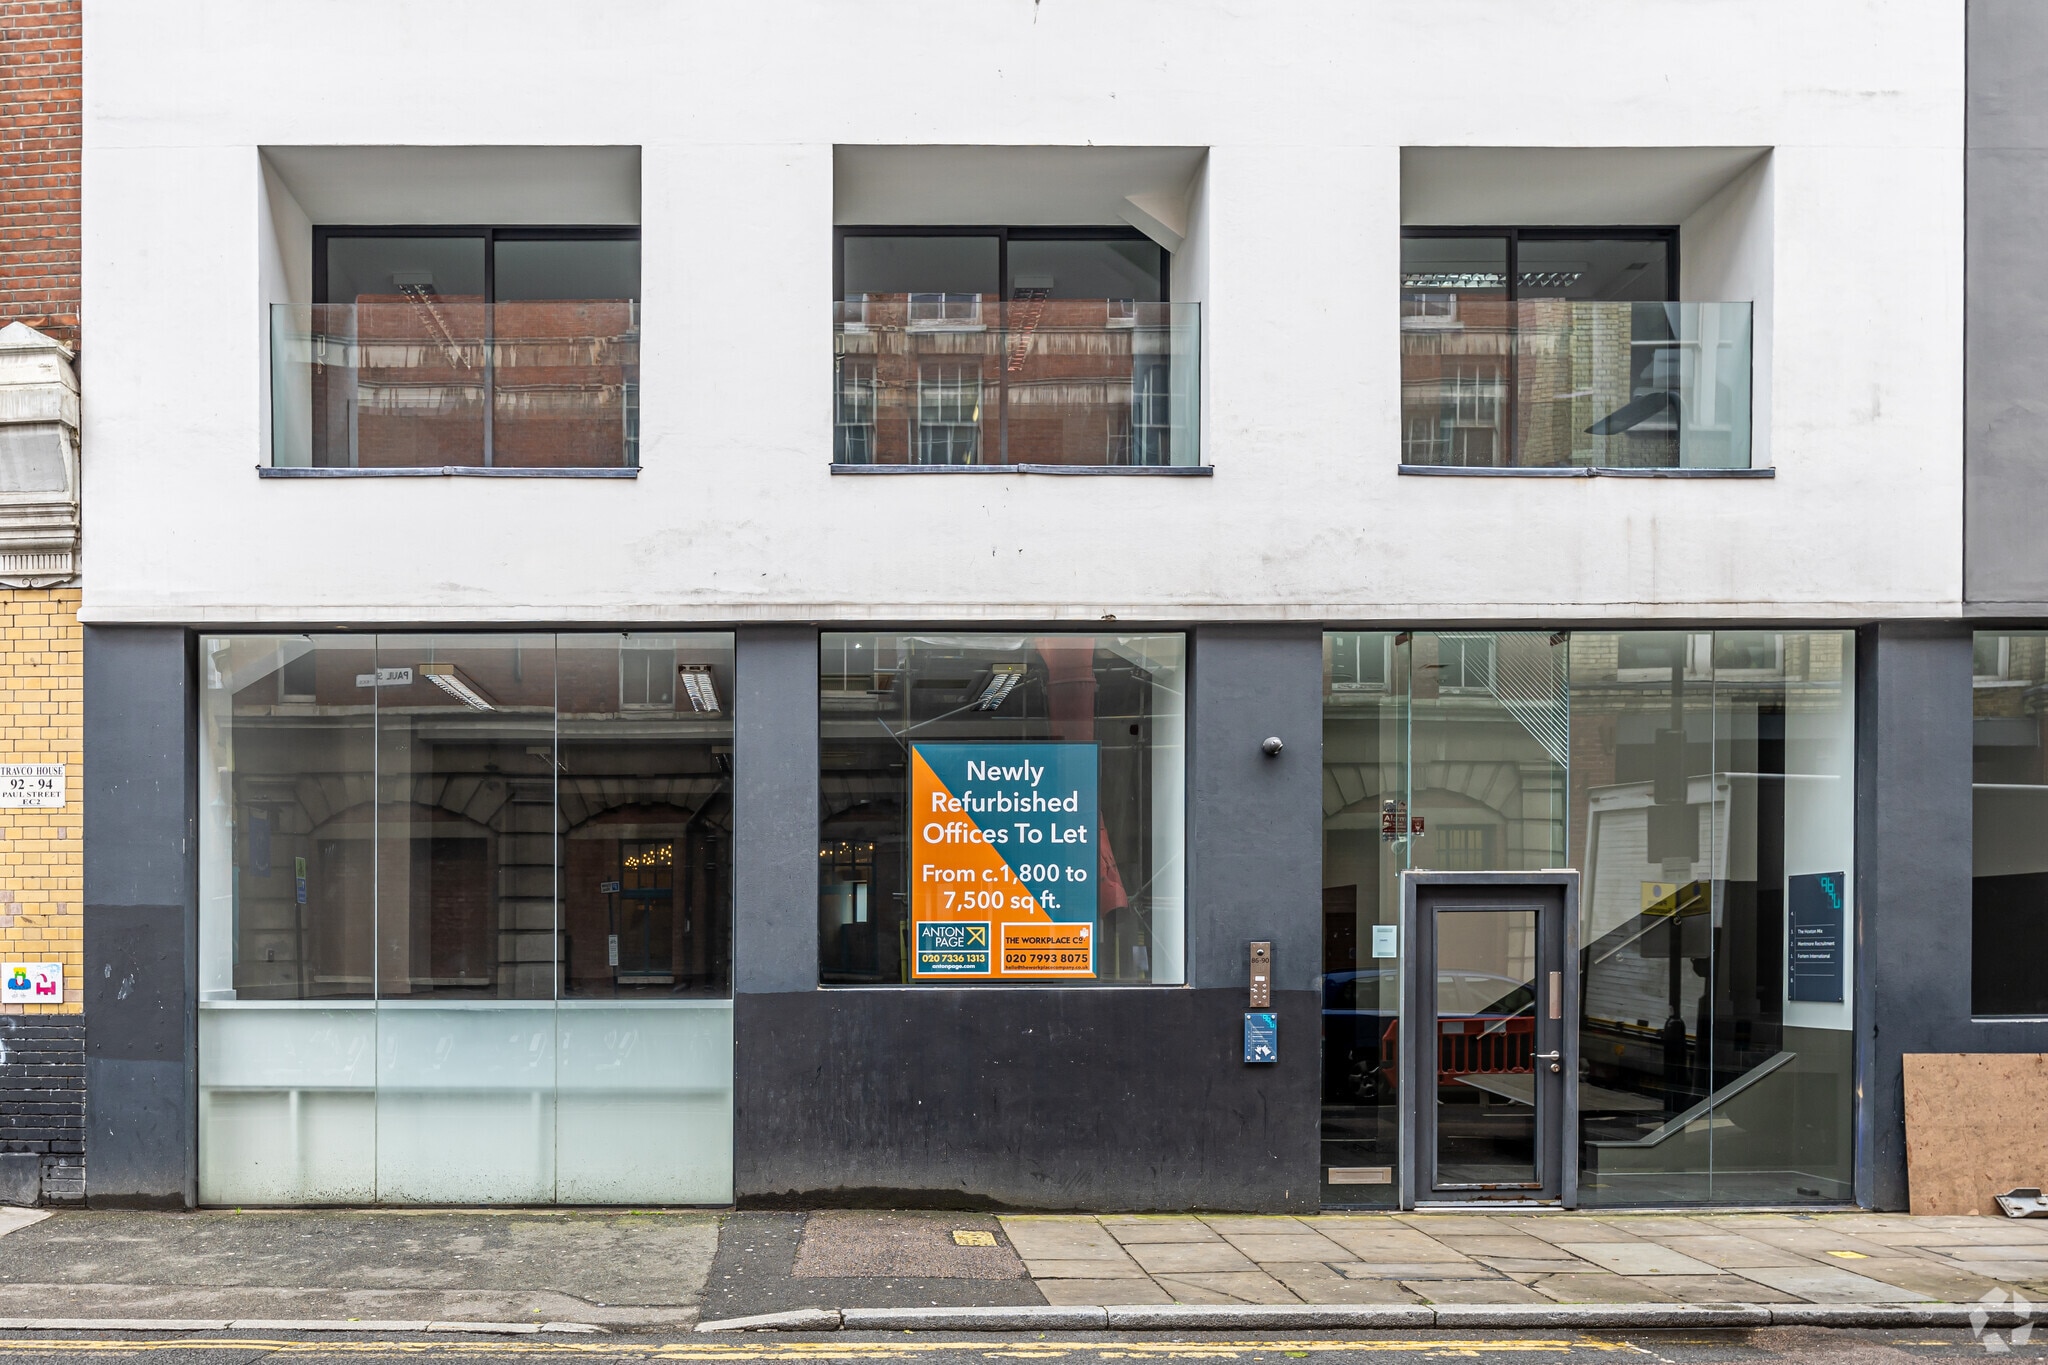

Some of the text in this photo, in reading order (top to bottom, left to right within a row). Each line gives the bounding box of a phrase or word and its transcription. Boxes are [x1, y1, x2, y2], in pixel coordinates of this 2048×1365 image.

[1, 766, 63, 776] TRAVCO HOUSE
[967, 759, 1044, 787] Newly
[10, 778, 25, 790] 92
[38, 778, 53, 790] 94
[931, 790, 1078, 813] Refurbished
[923, 822, 1088, 844] Offices To Let
[922, 864, 1088, 885] From c.1,800 to
[943, 889, 1061, 914] 7,500 sq ft.
[922, 926, 965, 937] ANTON
[935, 937, 965, 947] PAGE
[1005, 936, 1020, 944] THE
[1021, 936, 1071, 944] WORKPLACE
[922, 954, 986, 963] 020 7336 1313
[1005, 953, 1088, 963] 020 7993 8075
